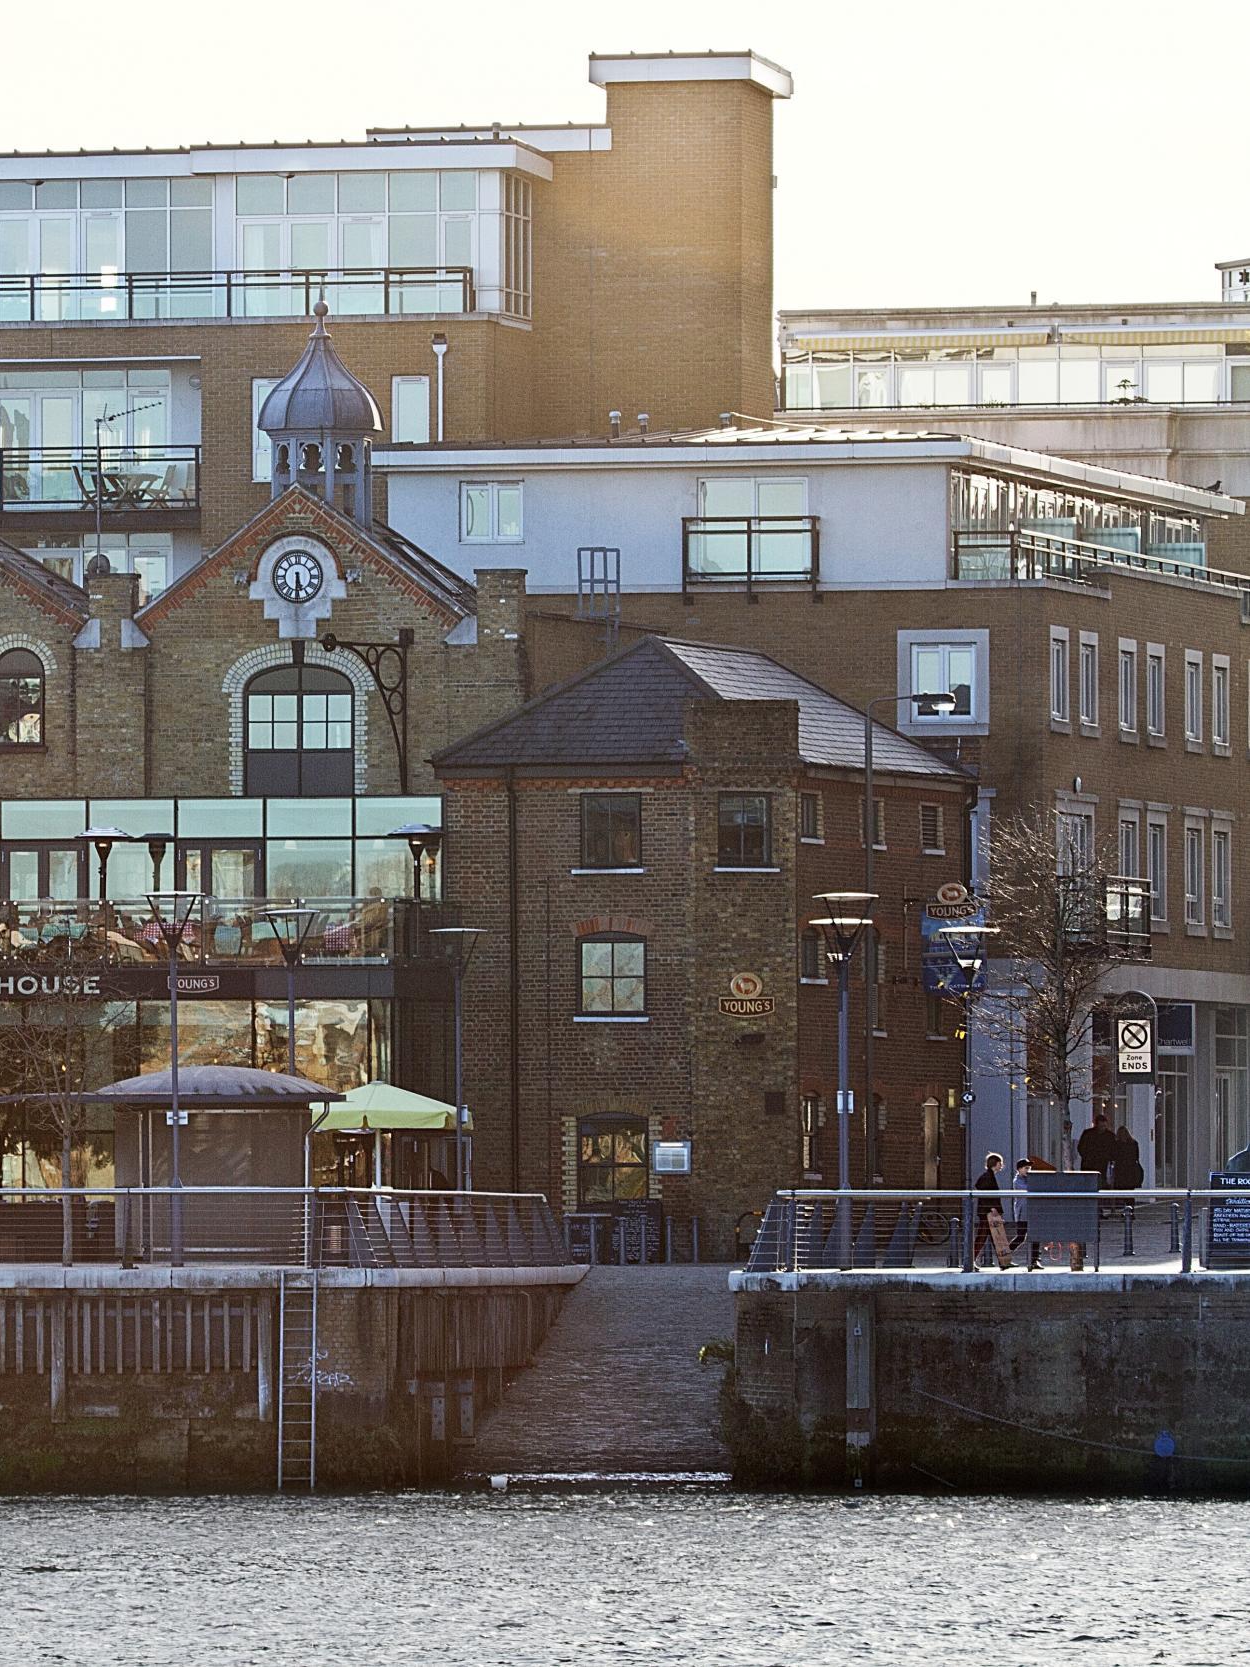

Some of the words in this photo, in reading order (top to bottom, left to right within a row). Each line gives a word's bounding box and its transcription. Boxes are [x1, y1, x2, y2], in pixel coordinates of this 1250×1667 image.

[929, 905, 975, 917] YOUNG'S
[177, 978, 215, 989] OUNG'S
[724, 1000, 771, 1013] YOUNG'S
[1121, 1062, 1148, 1070] ENDS
[1220, 1177, 1236, 1185] THE
